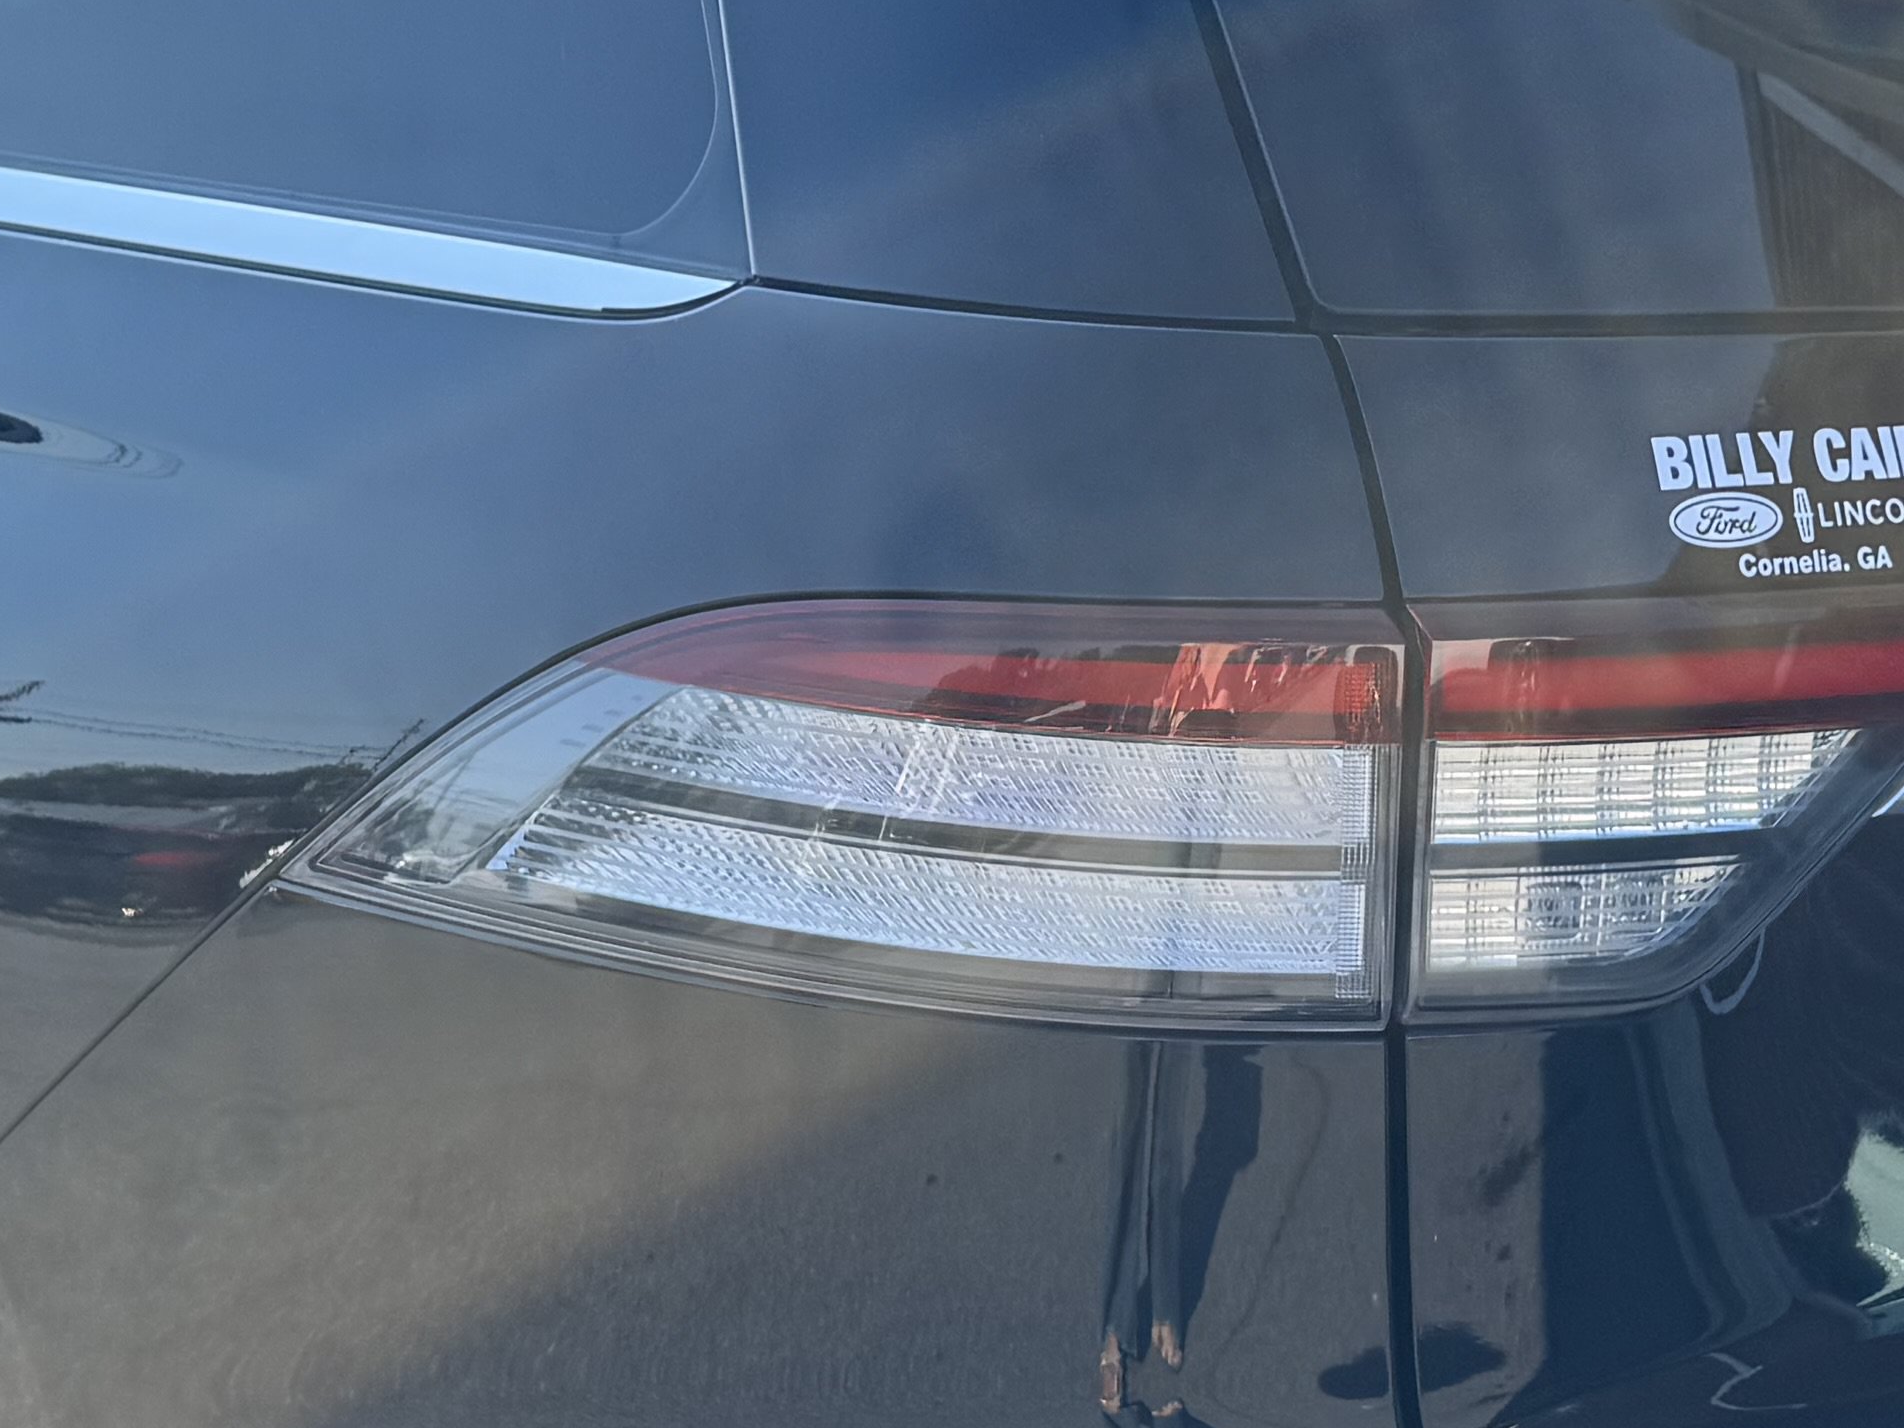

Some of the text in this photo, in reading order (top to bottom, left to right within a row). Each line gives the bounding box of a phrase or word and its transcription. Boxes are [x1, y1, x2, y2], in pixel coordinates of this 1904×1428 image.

[1651, 430, 1794, 490] BILLY
[1696, 504, 1758, 535] Ford
[1857, 545, 1893, 570] GA
